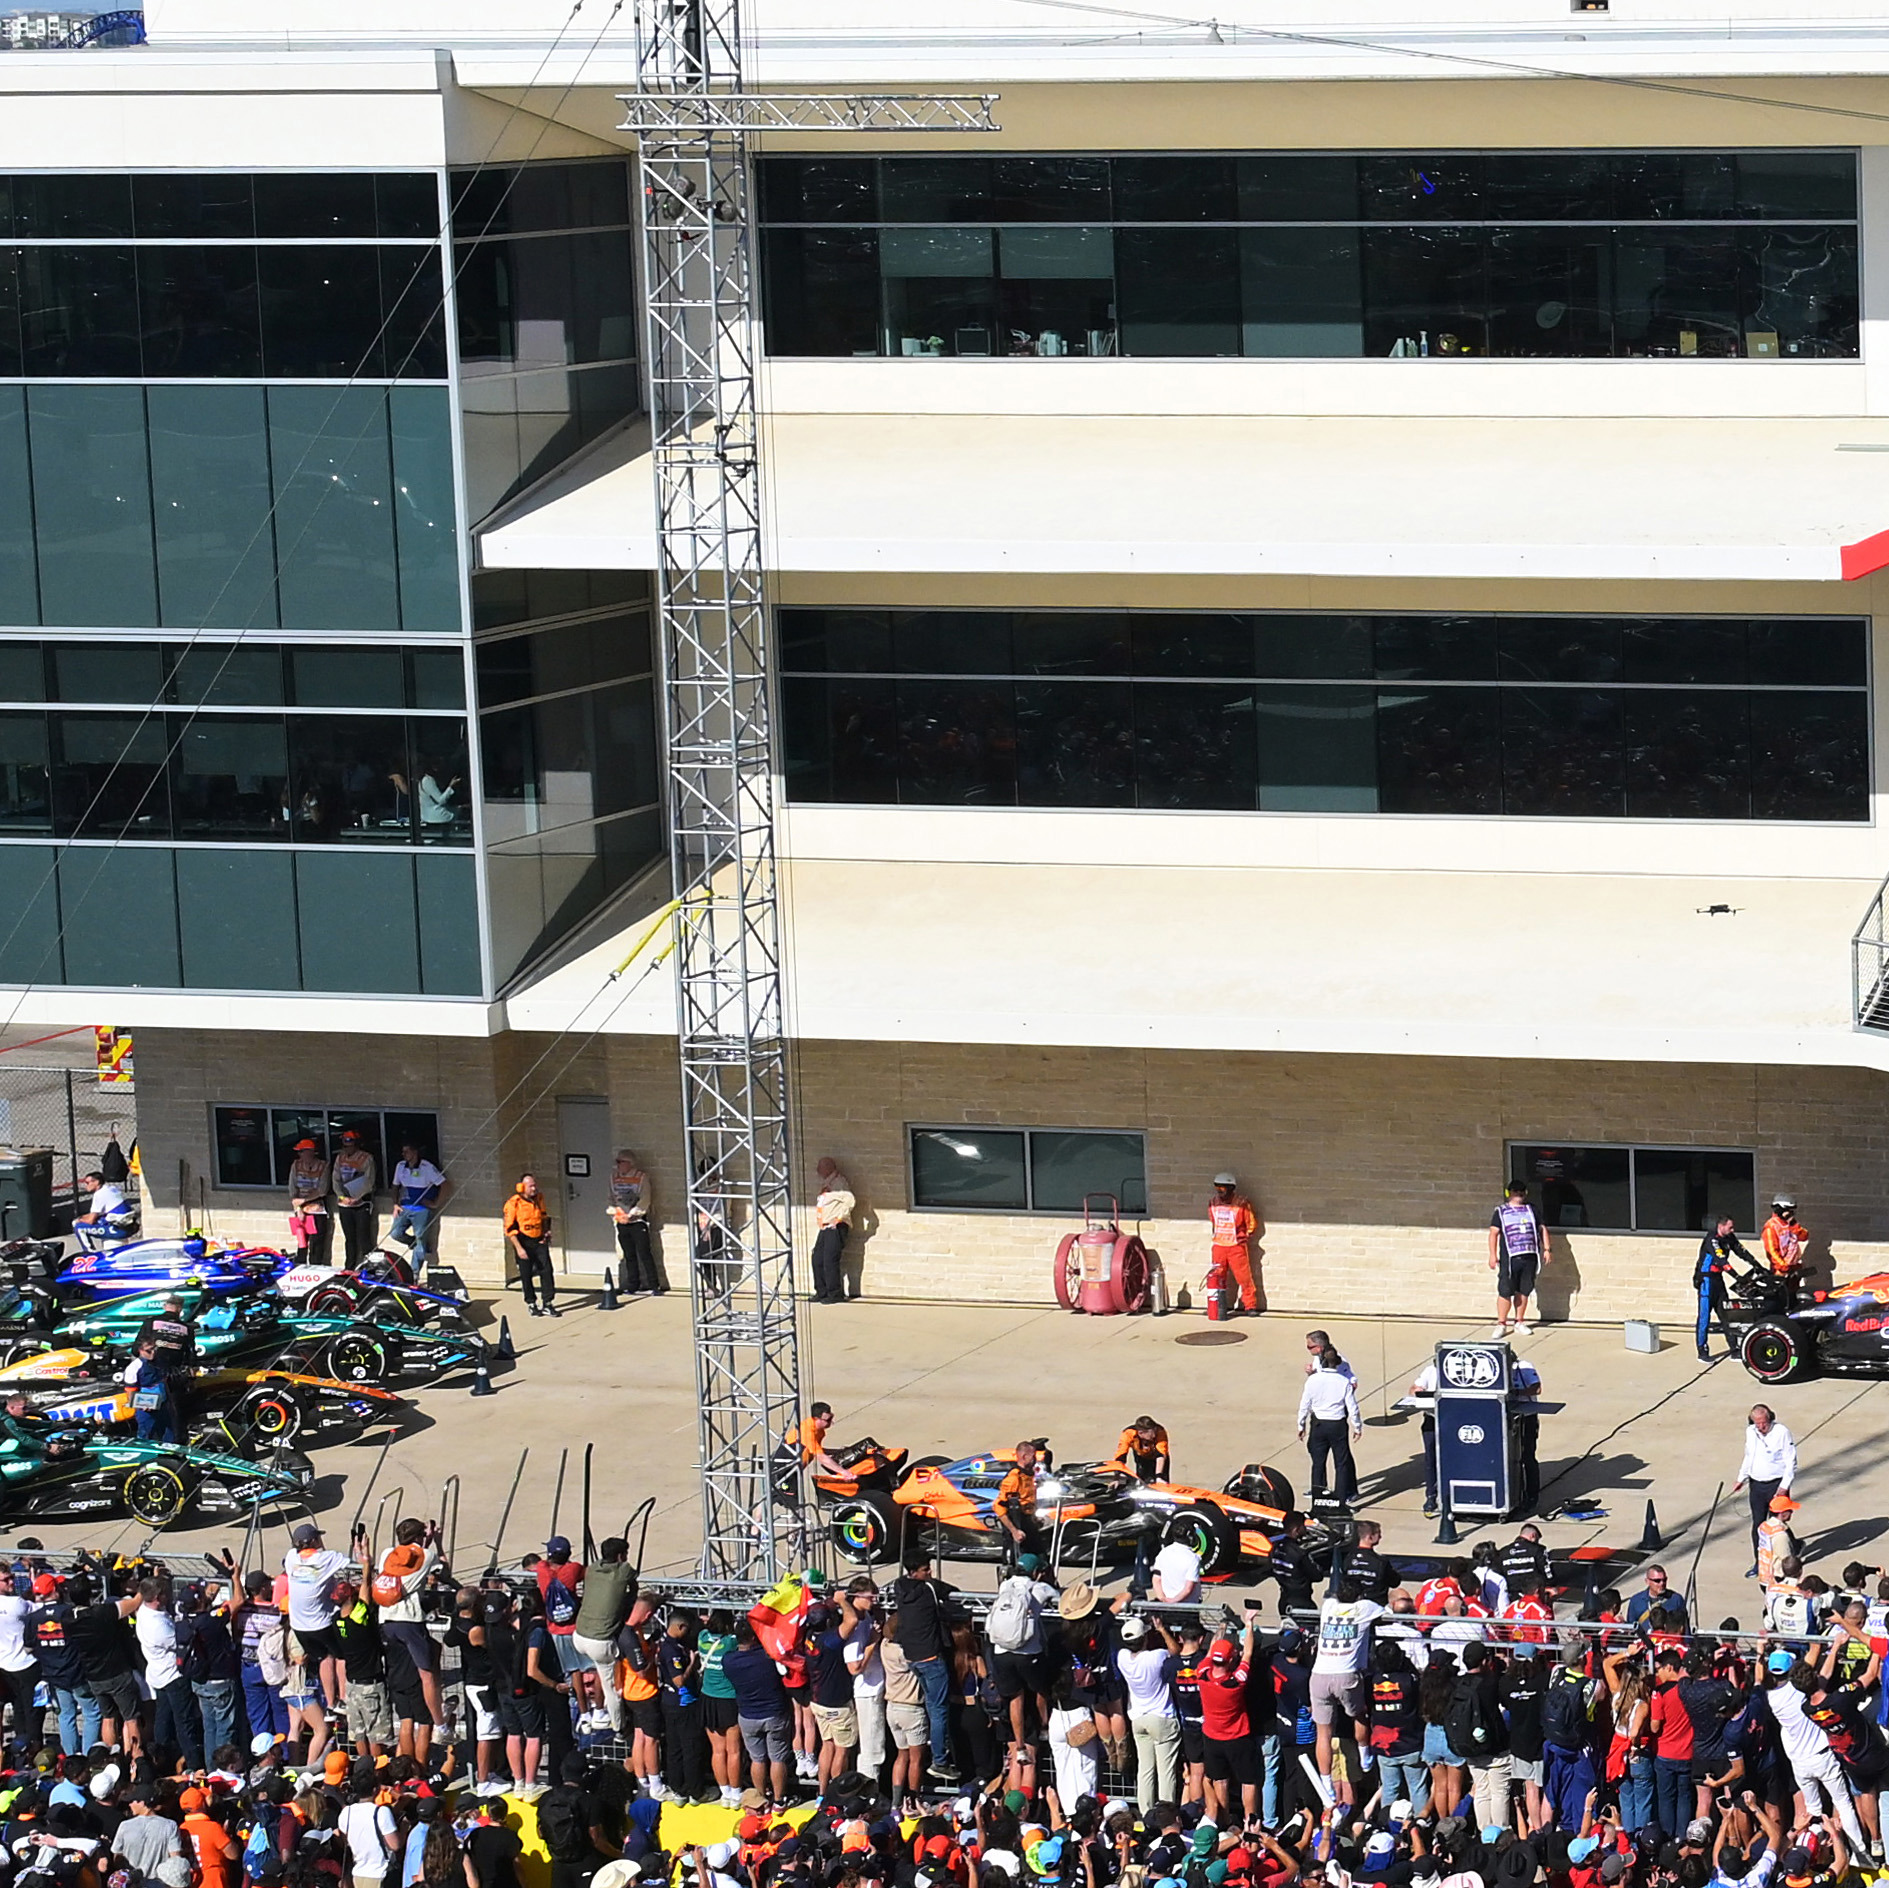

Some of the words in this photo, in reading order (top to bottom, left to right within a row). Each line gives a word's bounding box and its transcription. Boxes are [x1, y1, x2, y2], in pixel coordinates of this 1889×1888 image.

[72, 1256, 98, 1273] 22
[290, 1274, 320, 1283] HUGO
[1845, 1318, 1868, 1332] Red
[210, 1334, 235, 1344] BOSS
[35, 1367, 69, 1376] Castrol
[69, 1498, 112, 1511] cognizant
